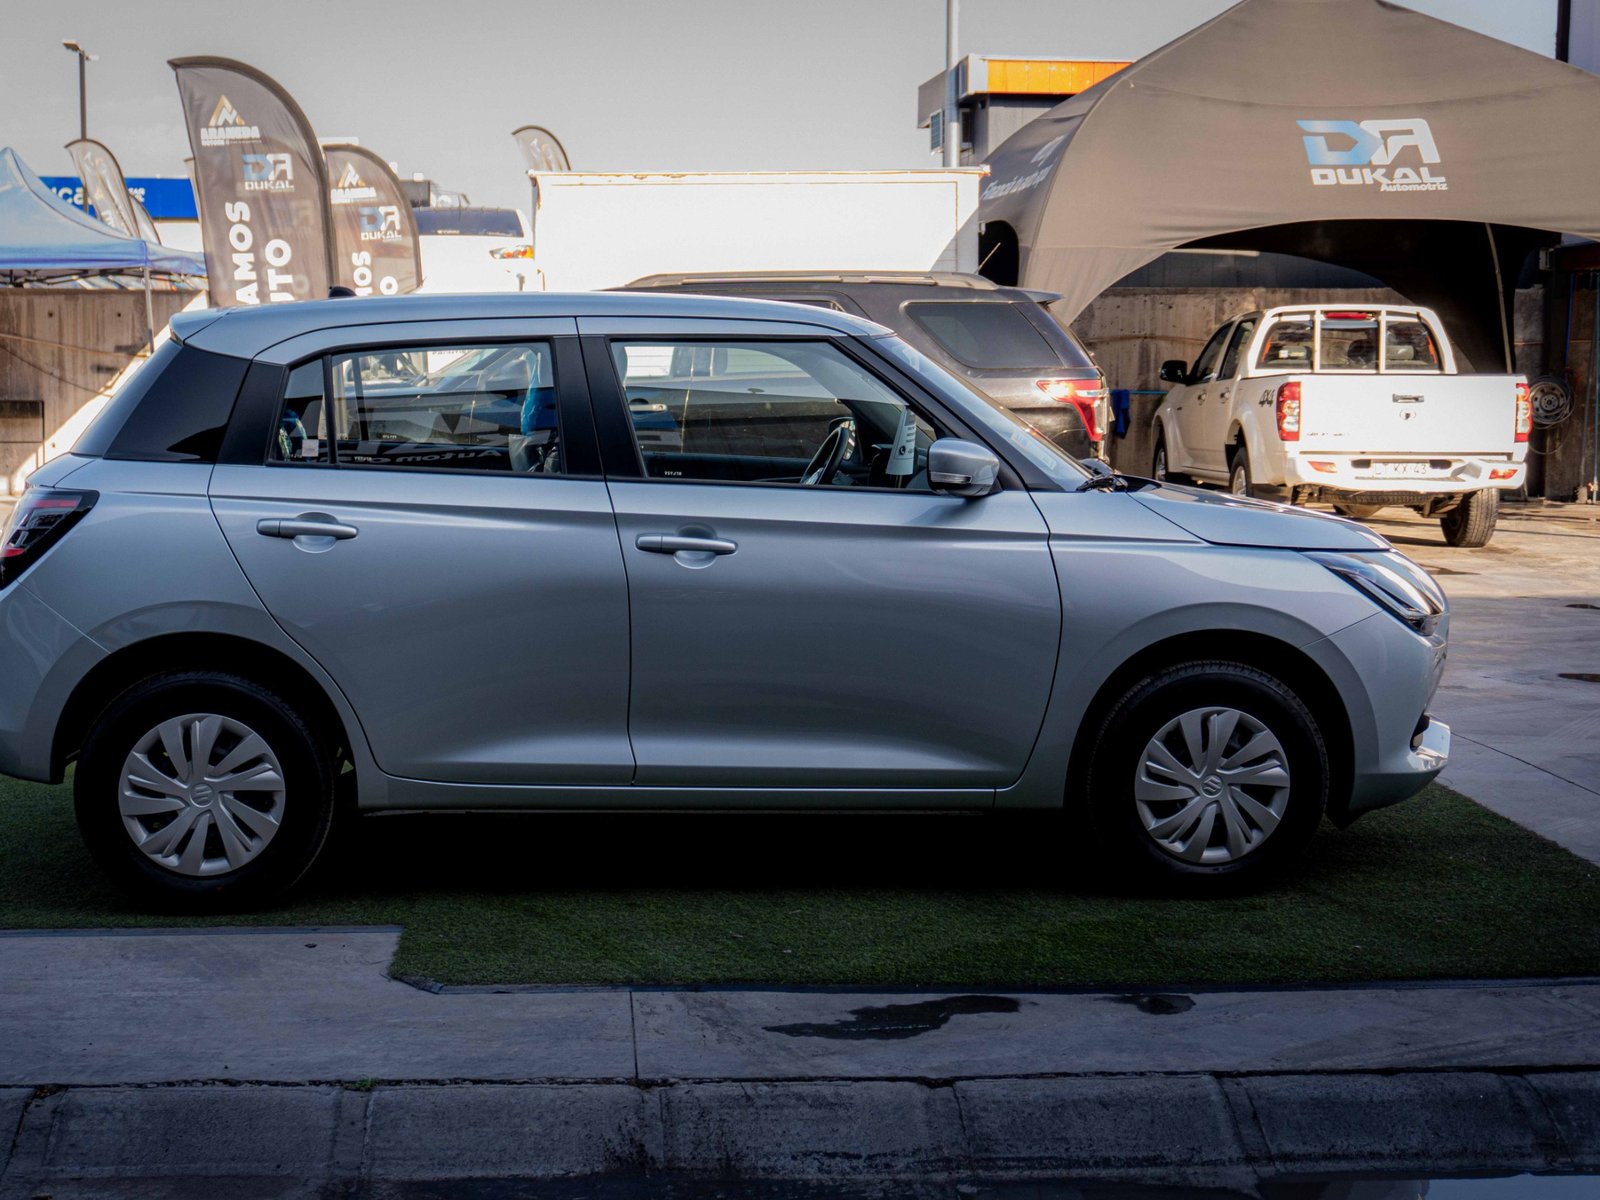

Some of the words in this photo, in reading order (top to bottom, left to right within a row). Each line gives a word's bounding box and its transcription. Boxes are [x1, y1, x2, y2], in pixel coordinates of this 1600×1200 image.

[1310, 166, 1446, 185] DUKAL
[244, 180, 295, 190] DUKAL
[1379, 182, 1448, 192] Automotriz
[361, 231, 402, 240] DUKAL
